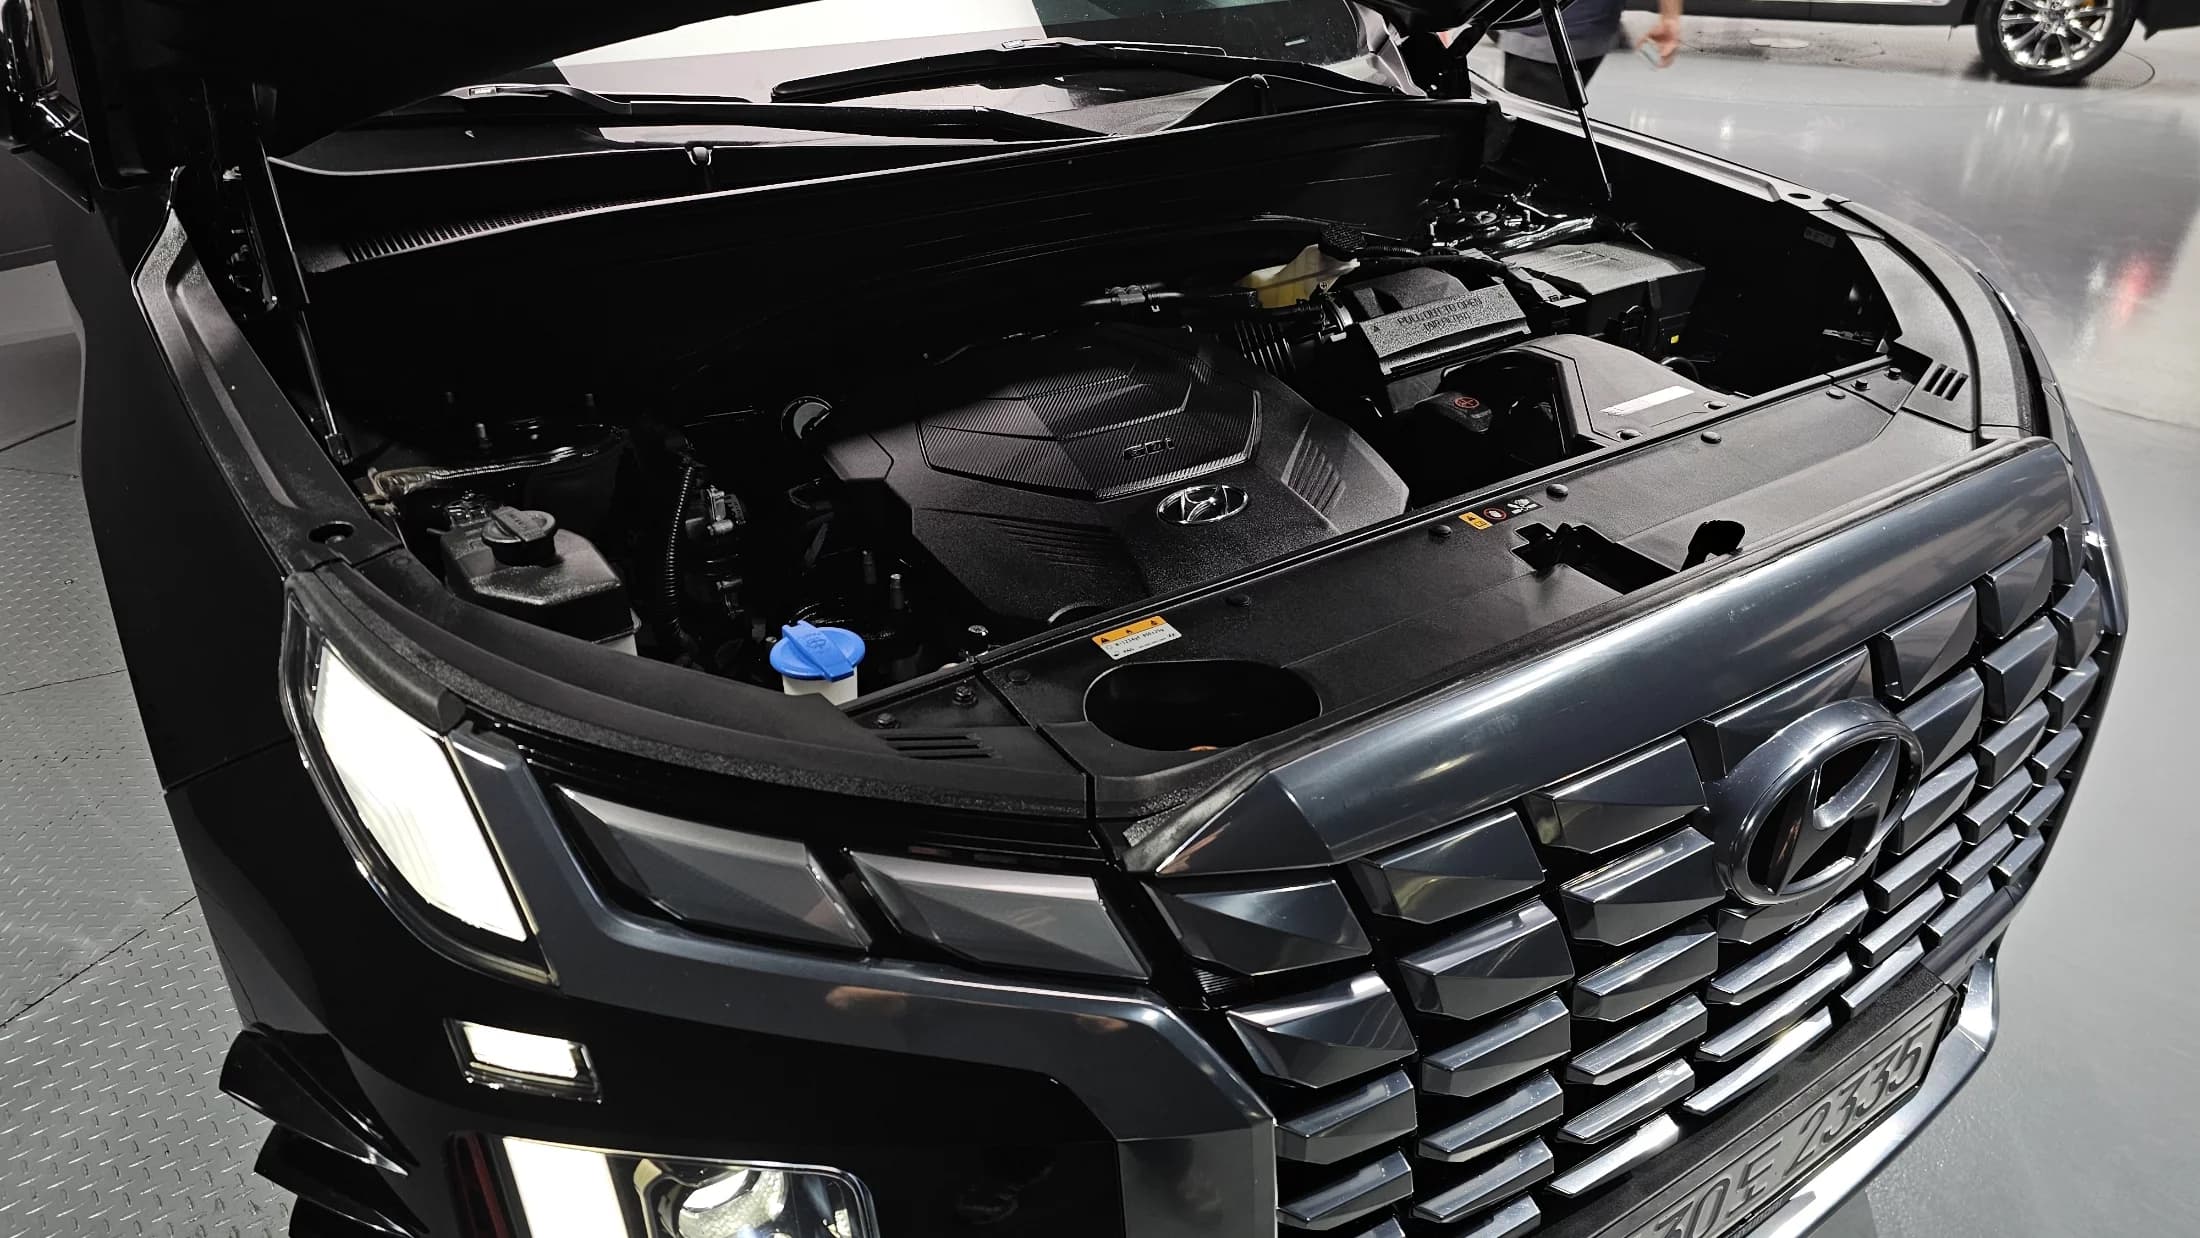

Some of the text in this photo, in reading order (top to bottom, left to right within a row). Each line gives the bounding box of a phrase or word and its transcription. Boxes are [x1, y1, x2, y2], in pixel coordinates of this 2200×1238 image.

[1397, 297, 1482, 326] PULL OUT TO OPEN
[1784, 1020, 1932, 1177] 2335
